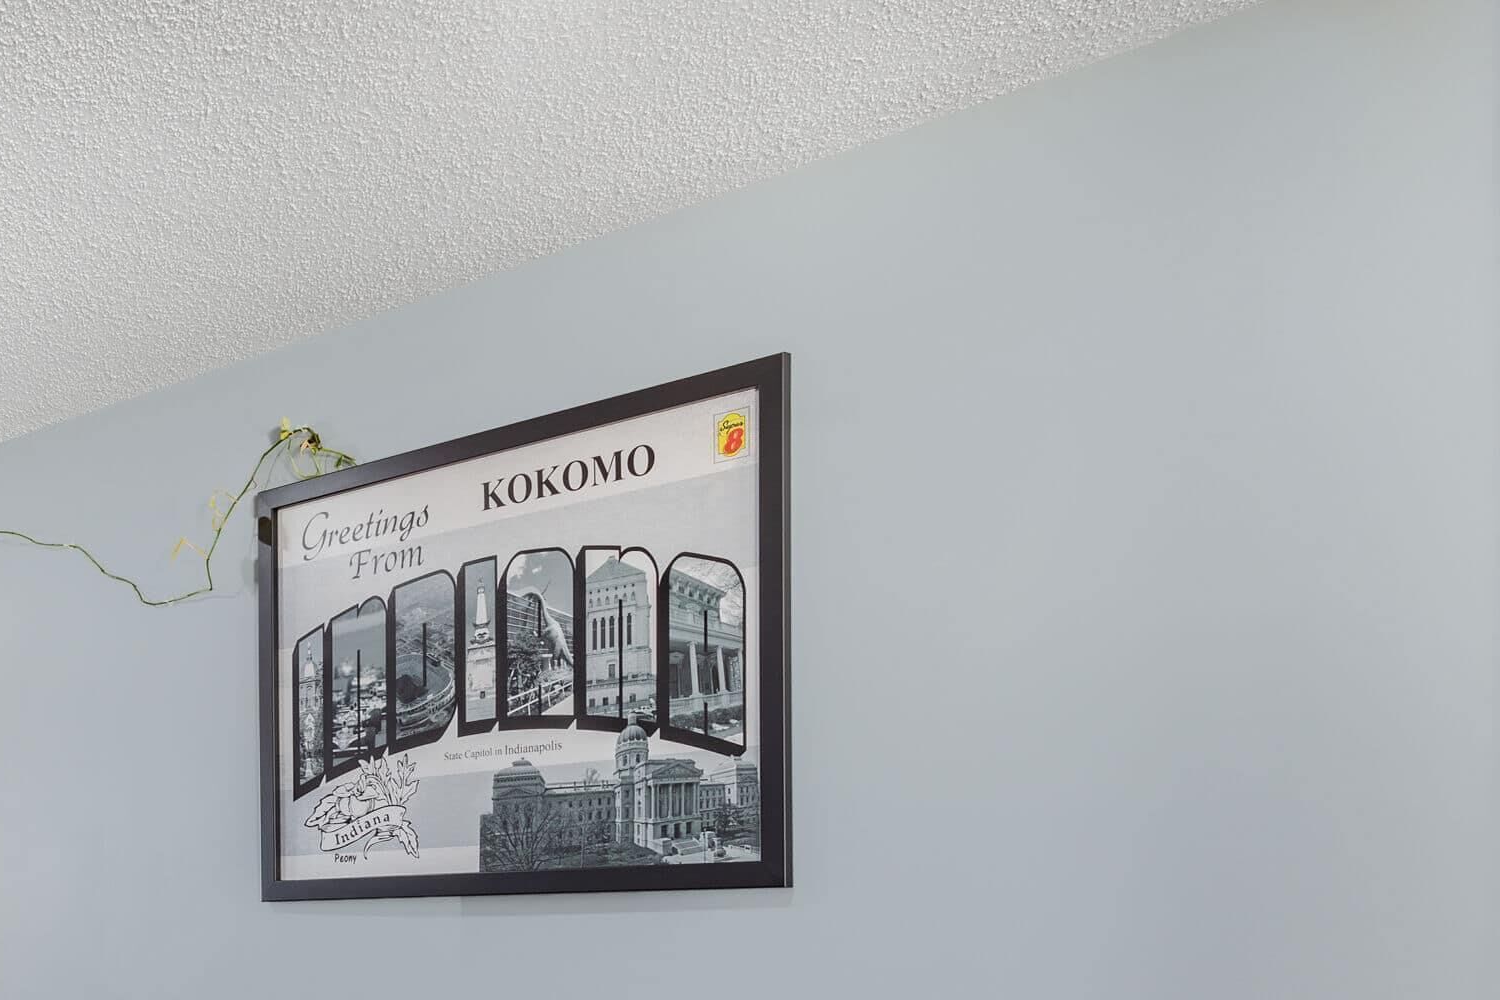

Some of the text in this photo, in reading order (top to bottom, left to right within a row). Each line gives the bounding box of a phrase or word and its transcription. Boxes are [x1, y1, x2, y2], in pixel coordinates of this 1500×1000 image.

[723, 426, 744, 455] 8
[477, 444, 656, 512] KOKOMO
[302, 504, 430, 562] Greetings
[349, 545, 425, 580] From
[443, 740, 563, 761] State Capitol in Indianapolis
[334, 813, 391, 846] Indiana
[334, 853, 357, 865] Peony
